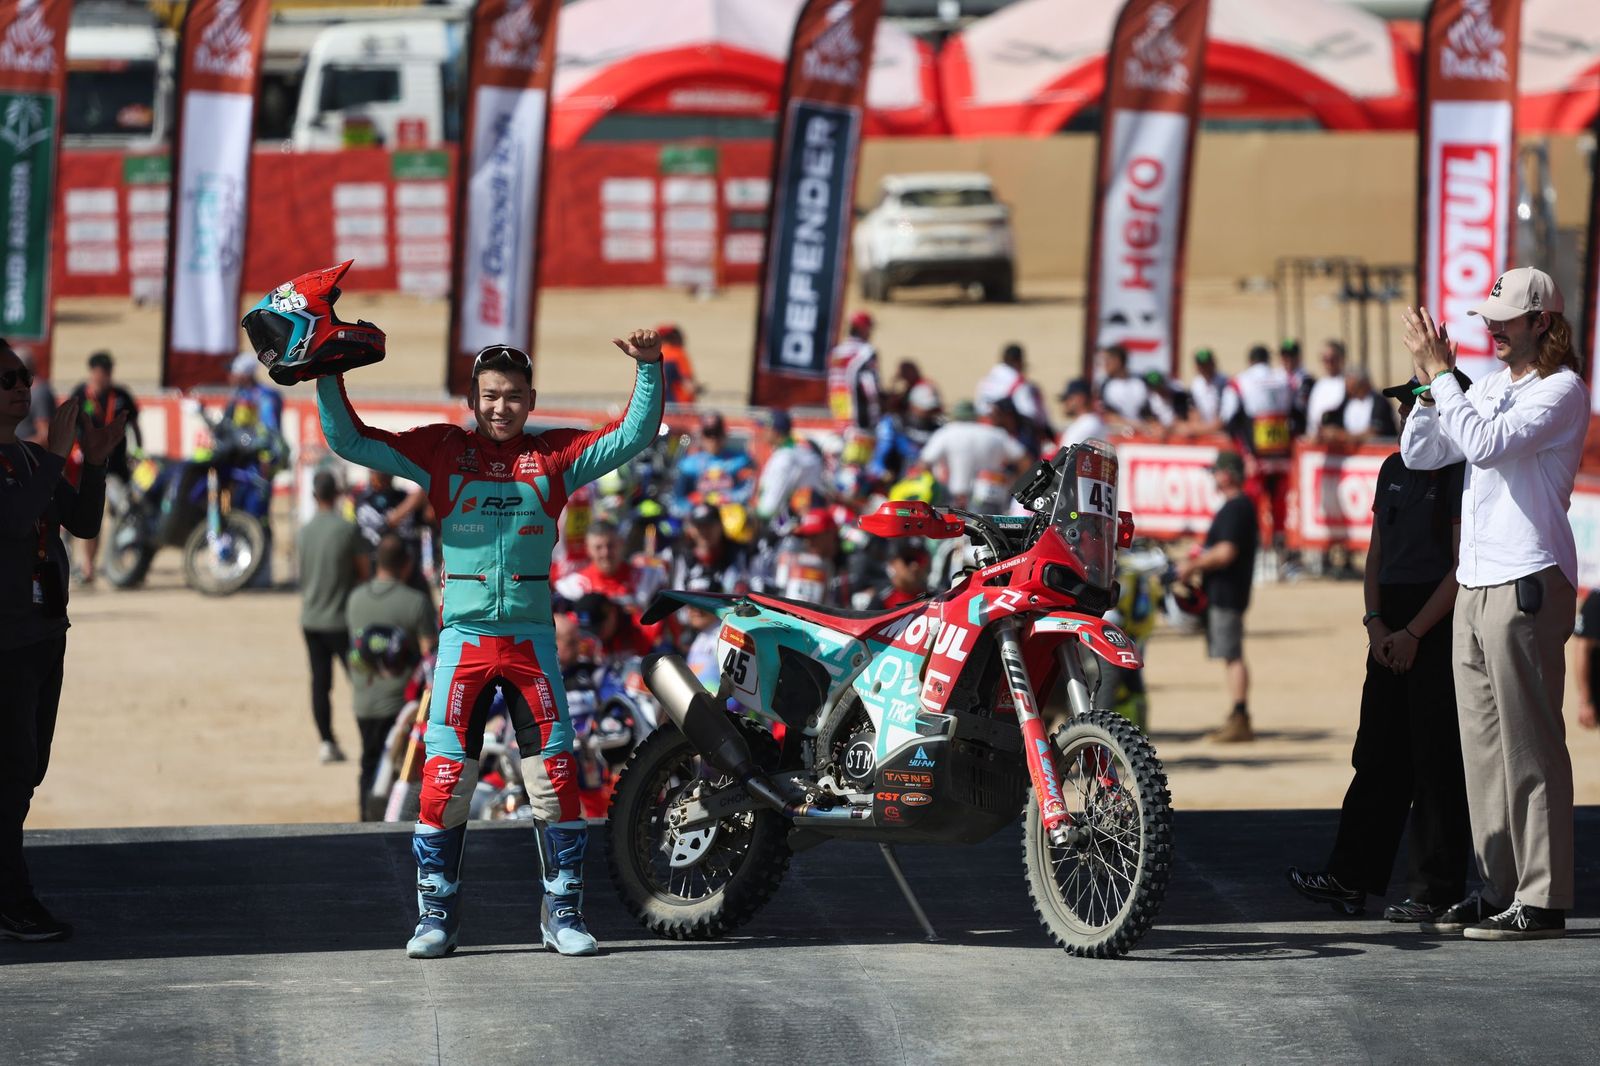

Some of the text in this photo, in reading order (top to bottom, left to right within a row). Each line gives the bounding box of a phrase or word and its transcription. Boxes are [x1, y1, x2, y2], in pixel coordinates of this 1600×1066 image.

[781, 114, 838, 367] DEFENDER
[1442, 151, 1494, 350] MOTUL
[280, 292, 307, 311] 45
[1089, 482, 1113, 516] 45
[452, 524, 485, 533] RACER
[518, 526, 543, 535] GIVI
[878, 613, 968, 662] MOTUL
[1104, 631, 1127, 644] STM
[721, 647, 750, 685] 45
[847, 750, 872, 770] STM
[876, 792, 900, 801] CST
